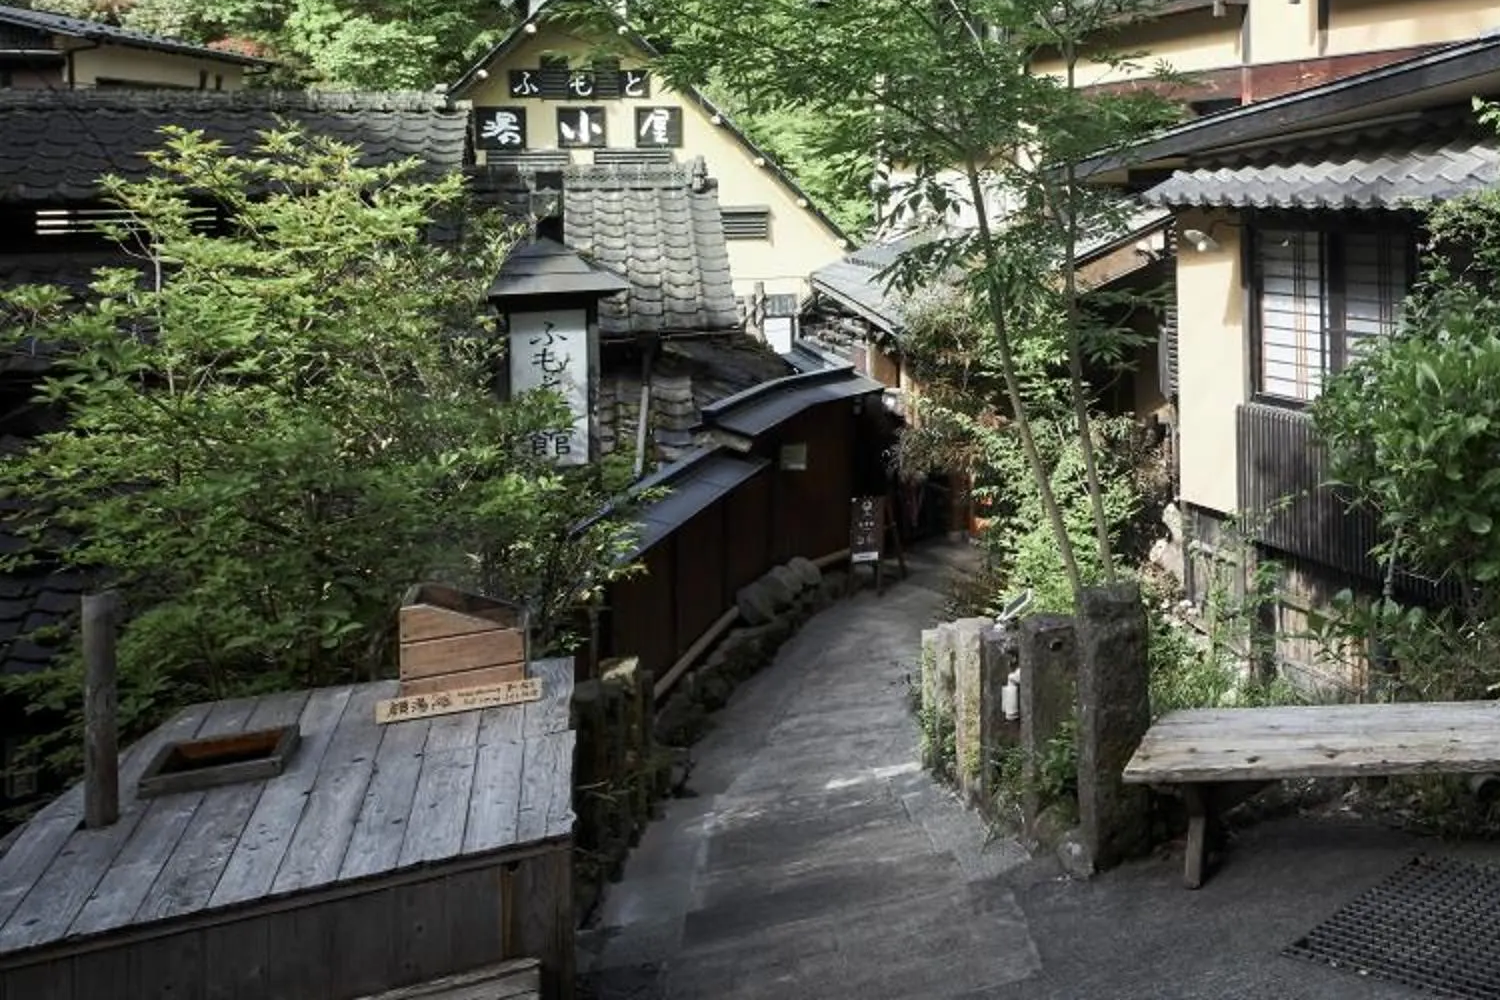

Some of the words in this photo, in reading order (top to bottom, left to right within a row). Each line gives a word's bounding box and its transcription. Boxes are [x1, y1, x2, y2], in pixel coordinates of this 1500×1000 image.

[512, 71, 644, 97] ふもと
[481, 109, 670, 145] 湯小屋
[528, 321, 577, 458] ふもと館
